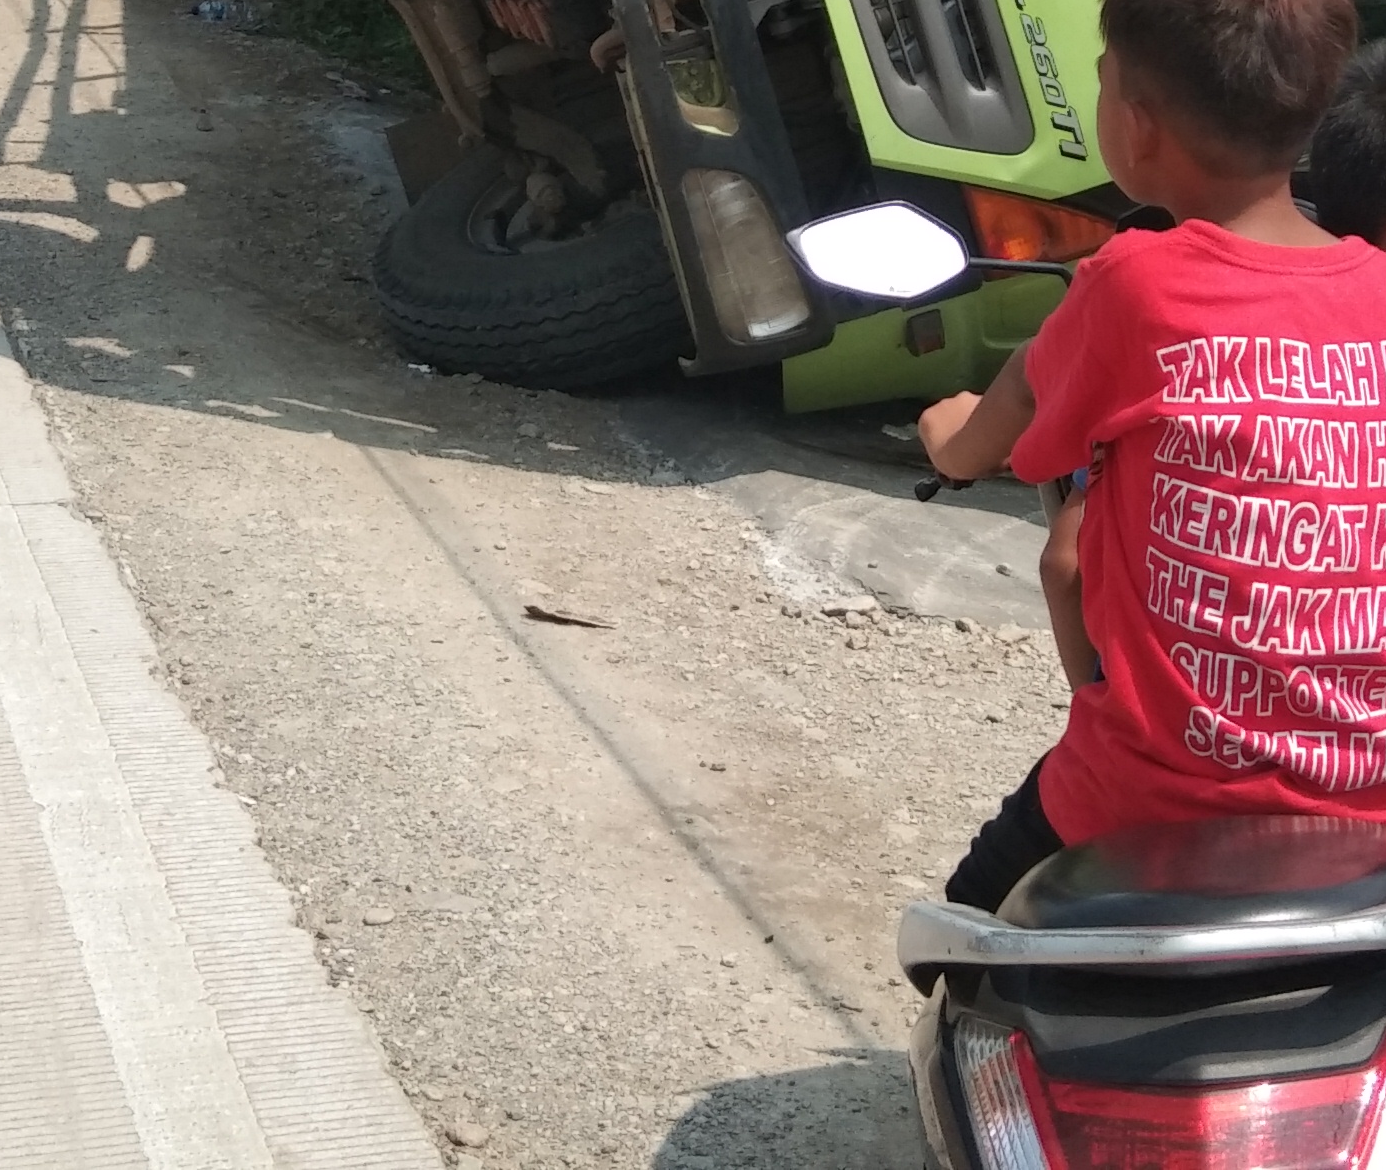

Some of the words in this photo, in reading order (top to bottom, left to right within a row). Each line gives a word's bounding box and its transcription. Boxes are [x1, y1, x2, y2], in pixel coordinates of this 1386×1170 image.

[1156, 336, 1253, 404] TAK
[1255, 337, 1380, 406] LELAH
[1149, 414, 1243, 478] TAK
[1241, 415, 1360, 488] AKAN
[1148, 472, 1368, 572] KERINGAT
[1145, 545, 1229, 636] THE
[1230, 582, 1333, 656] JAK
